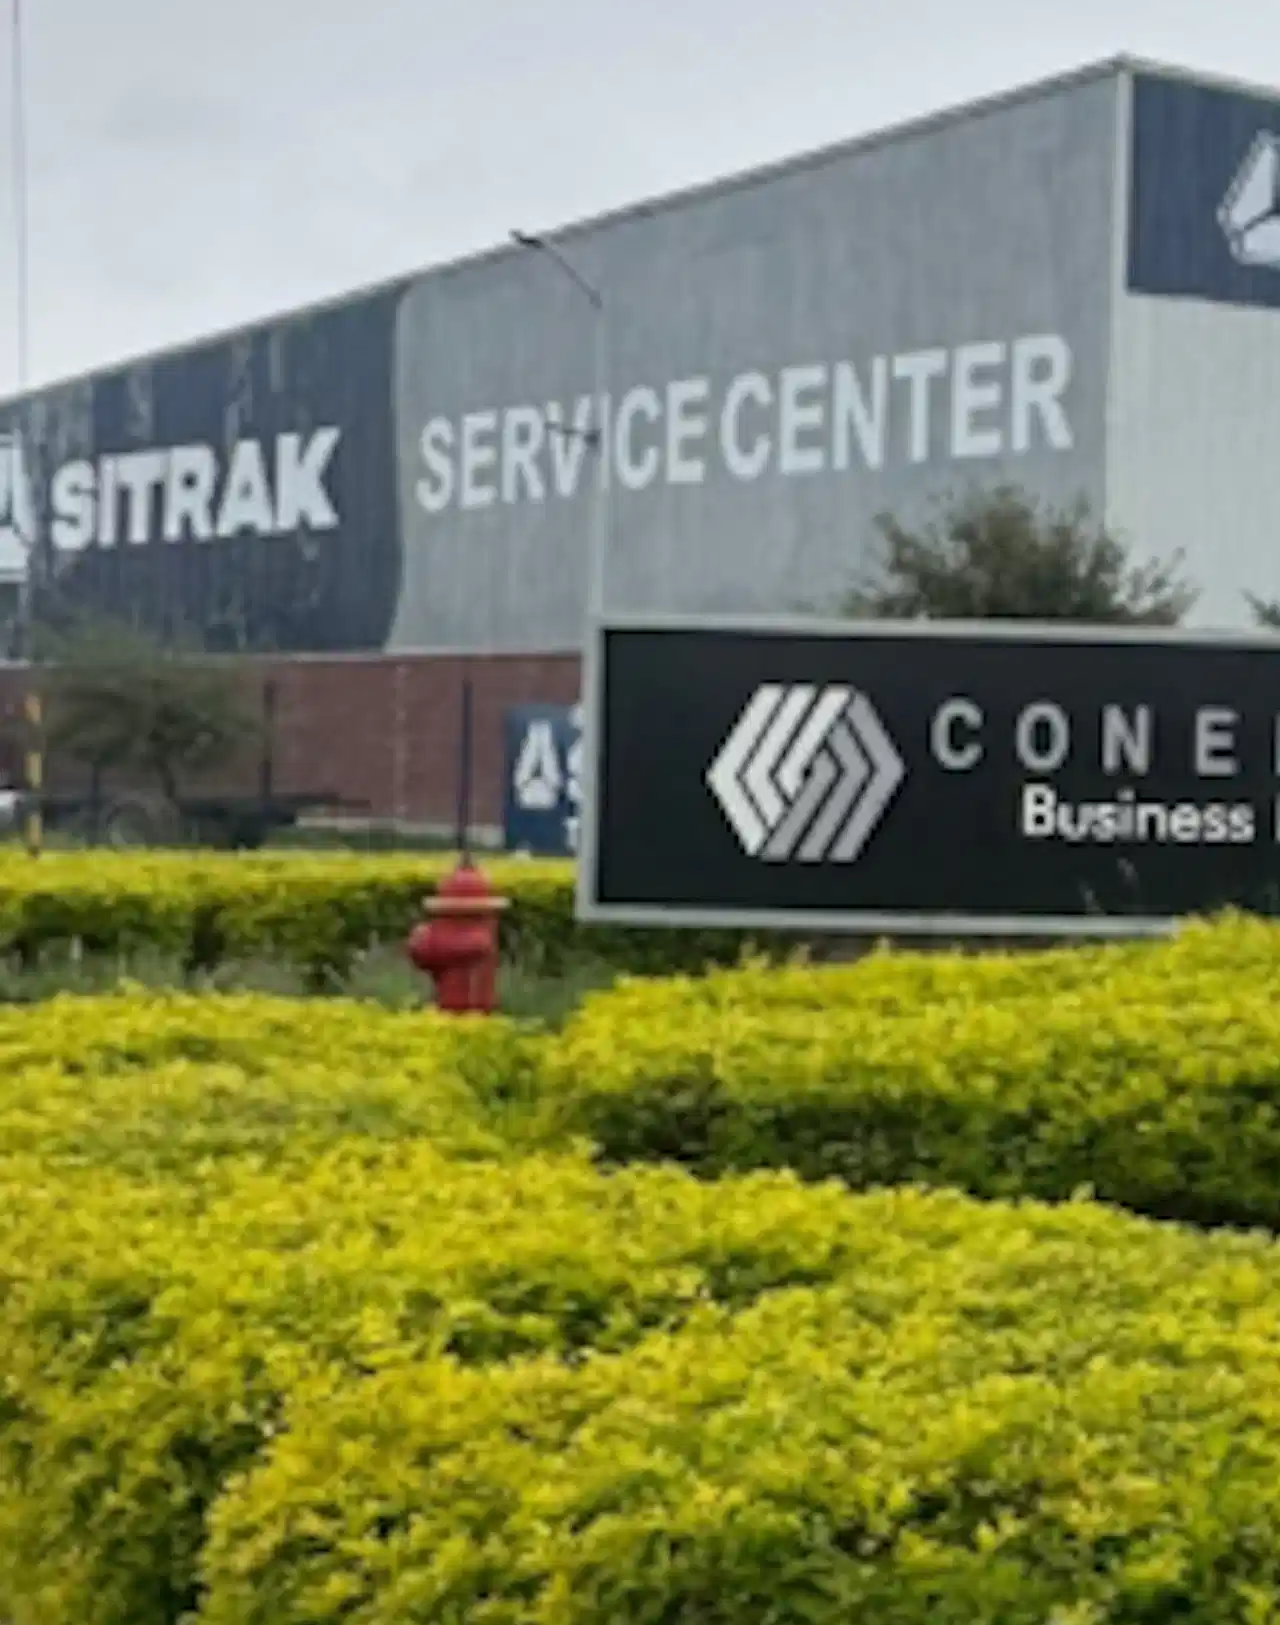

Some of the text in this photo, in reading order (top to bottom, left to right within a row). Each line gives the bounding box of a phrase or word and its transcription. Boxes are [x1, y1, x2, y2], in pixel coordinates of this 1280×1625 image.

[415, 332, 1075, 512] SERVICE CENTER
[51, 426, 341, 553] SITRAK
[1020, 784, 1256, 845] Business
